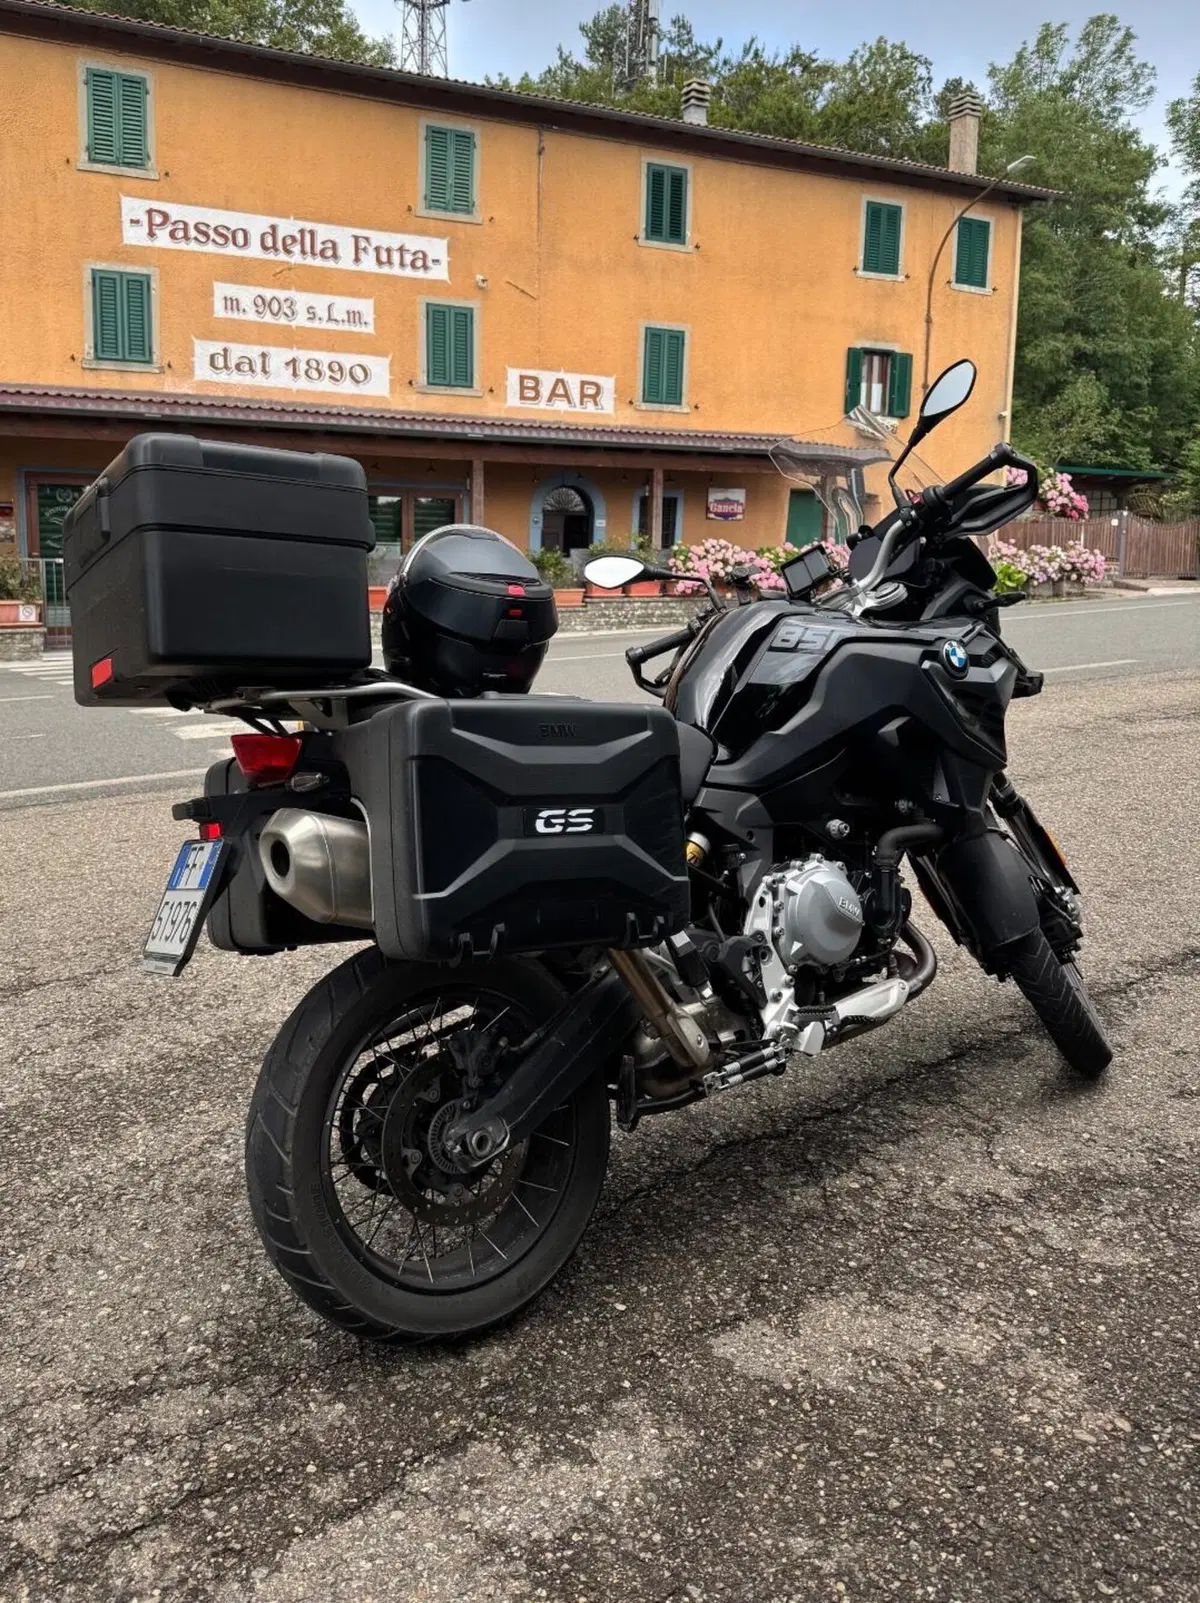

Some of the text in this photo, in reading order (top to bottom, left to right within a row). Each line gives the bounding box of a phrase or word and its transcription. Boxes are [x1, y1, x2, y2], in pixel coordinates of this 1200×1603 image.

[260, 223, 341, 264] della
[222, 293, 247, 315] m.
[253, 294, 297, 321] 903
[209, 346, 371, 386] dal 1890
[519, 374, 604, 410] BAR
[539, 722, 577, 738] BMW
[535, 808, 595, 834] GS
[151, 901, 197, 943] 51976
